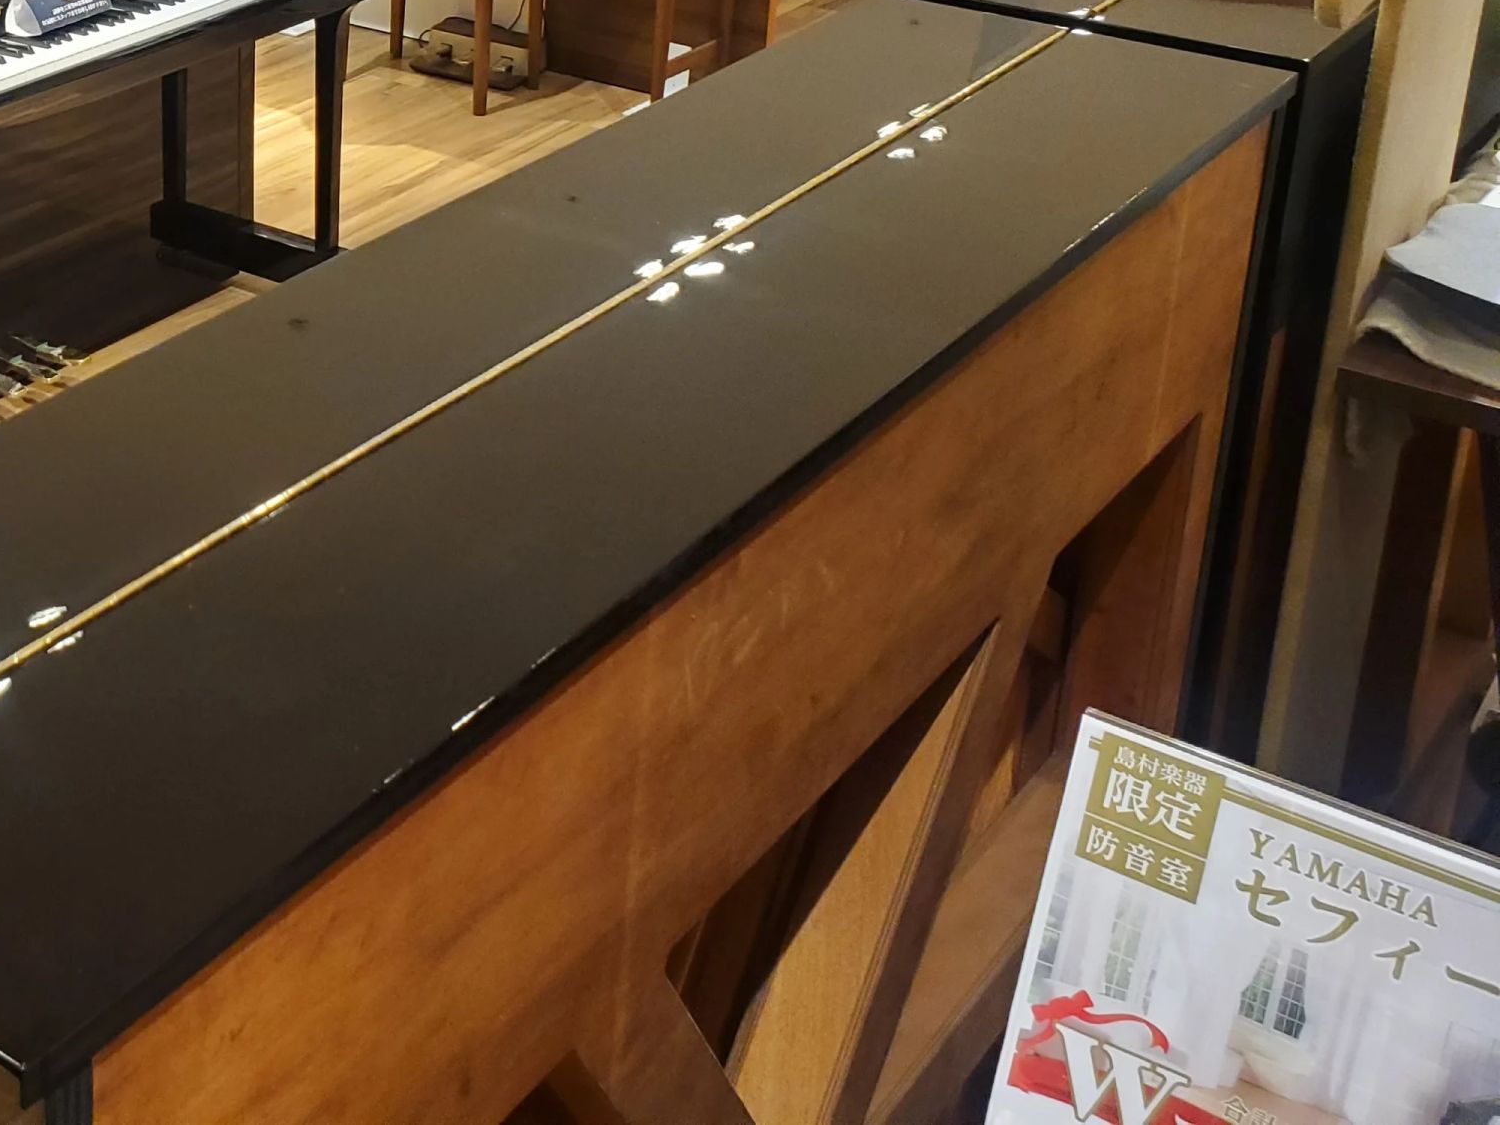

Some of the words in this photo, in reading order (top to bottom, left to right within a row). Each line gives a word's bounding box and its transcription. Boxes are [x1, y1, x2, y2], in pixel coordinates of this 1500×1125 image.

[1102, 767, 1203, 842] 限定
[1112, 745, 1208, 797] 島村楽器
[1085, 824, 1193, 894] 防音室
[1249, 828, 1438, 928] YAMAHA
[1234, 868, 1500, 996] セフィー
[1054, 1022, 1192, 1125] W
